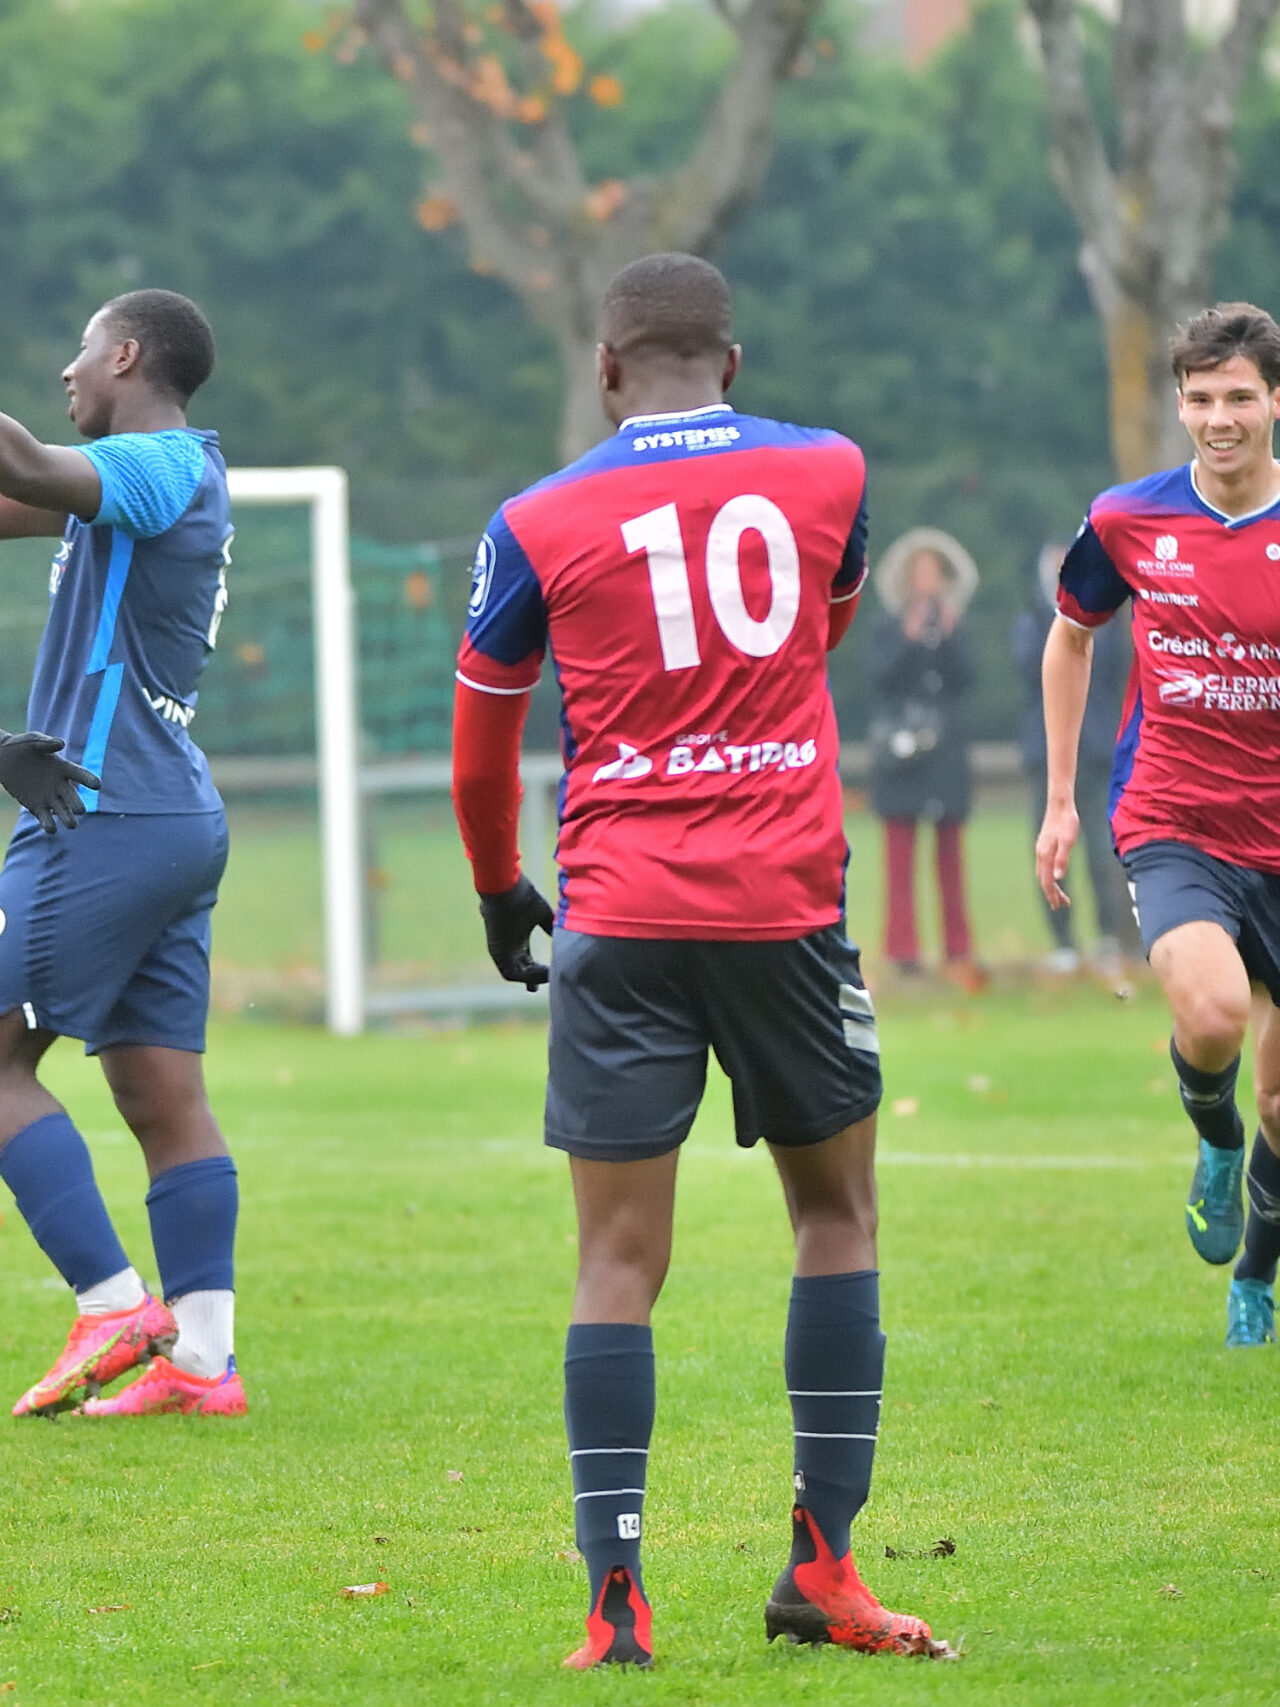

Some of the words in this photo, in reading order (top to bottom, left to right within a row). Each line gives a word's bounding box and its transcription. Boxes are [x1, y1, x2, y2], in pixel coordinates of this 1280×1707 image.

[619, 493, 801, 672] 10
[1147, 630, 1212, 658] Crédit
[1204, 673, 1280, 694] CLERM
